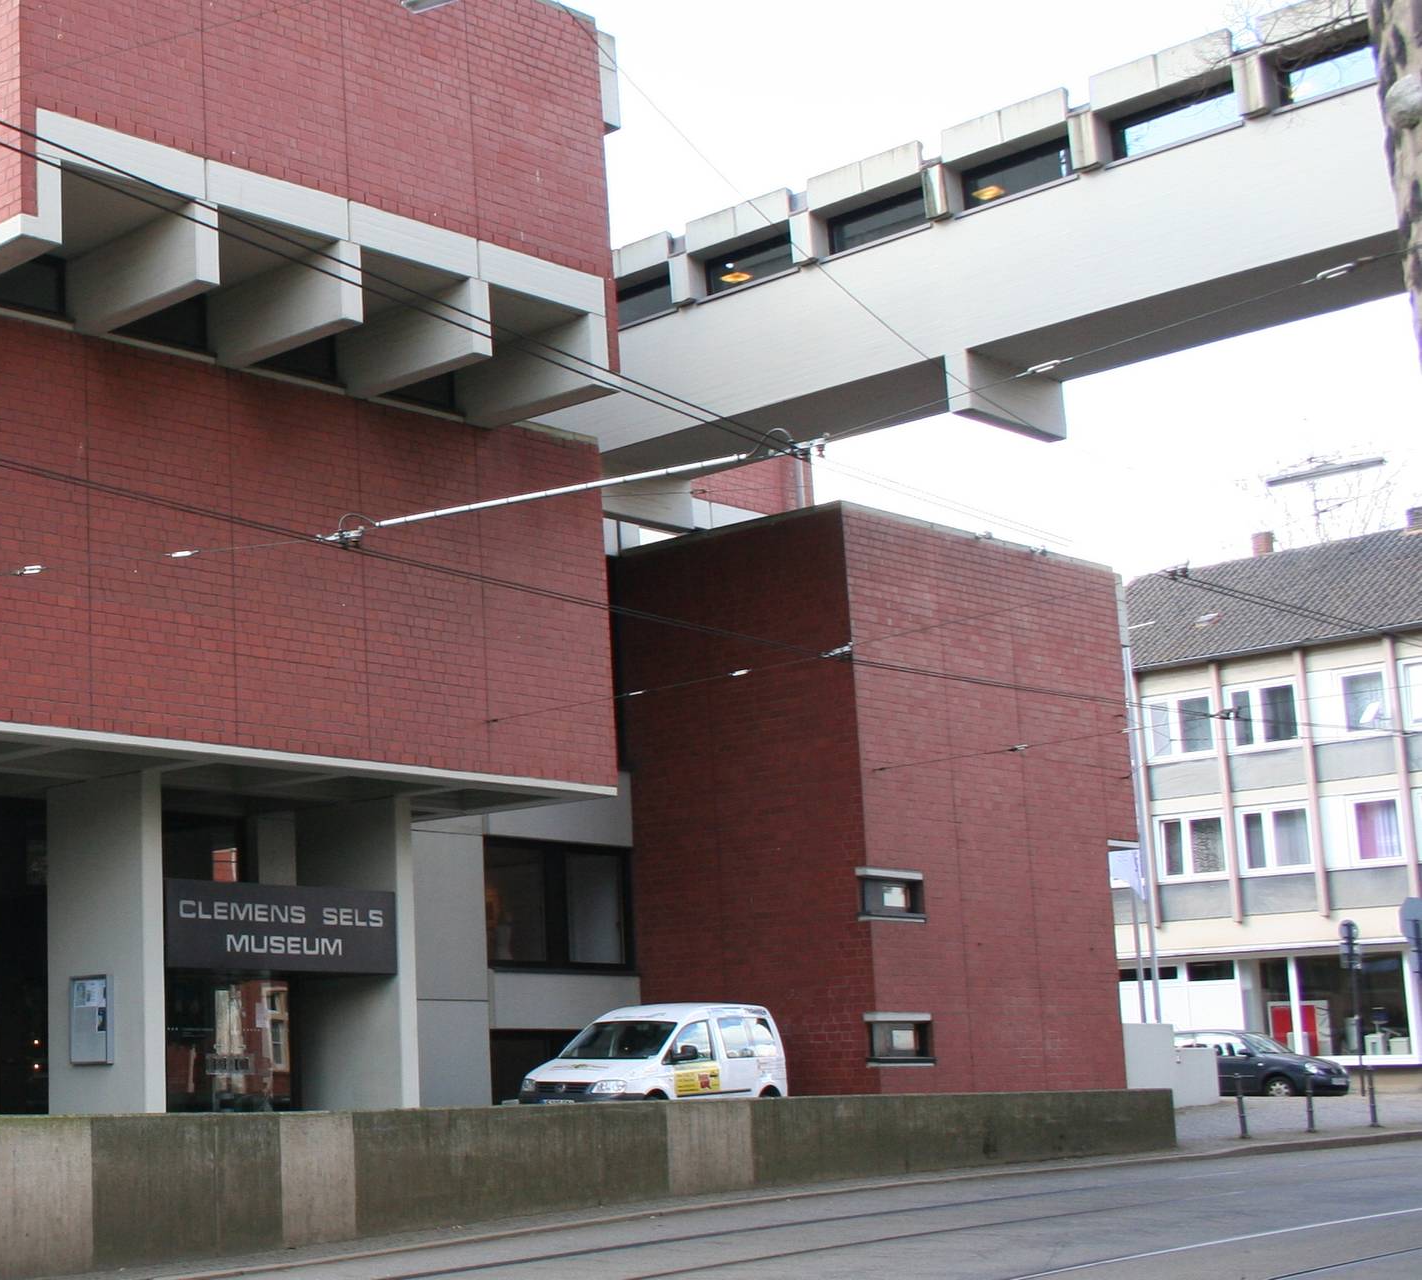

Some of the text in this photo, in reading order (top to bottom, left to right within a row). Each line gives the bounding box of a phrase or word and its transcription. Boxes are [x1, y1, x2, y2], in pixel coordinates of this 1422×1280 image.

[179, 899, 384, 928] CLEMENS SELS
[226, 934, 343, 956] MUSEUM
